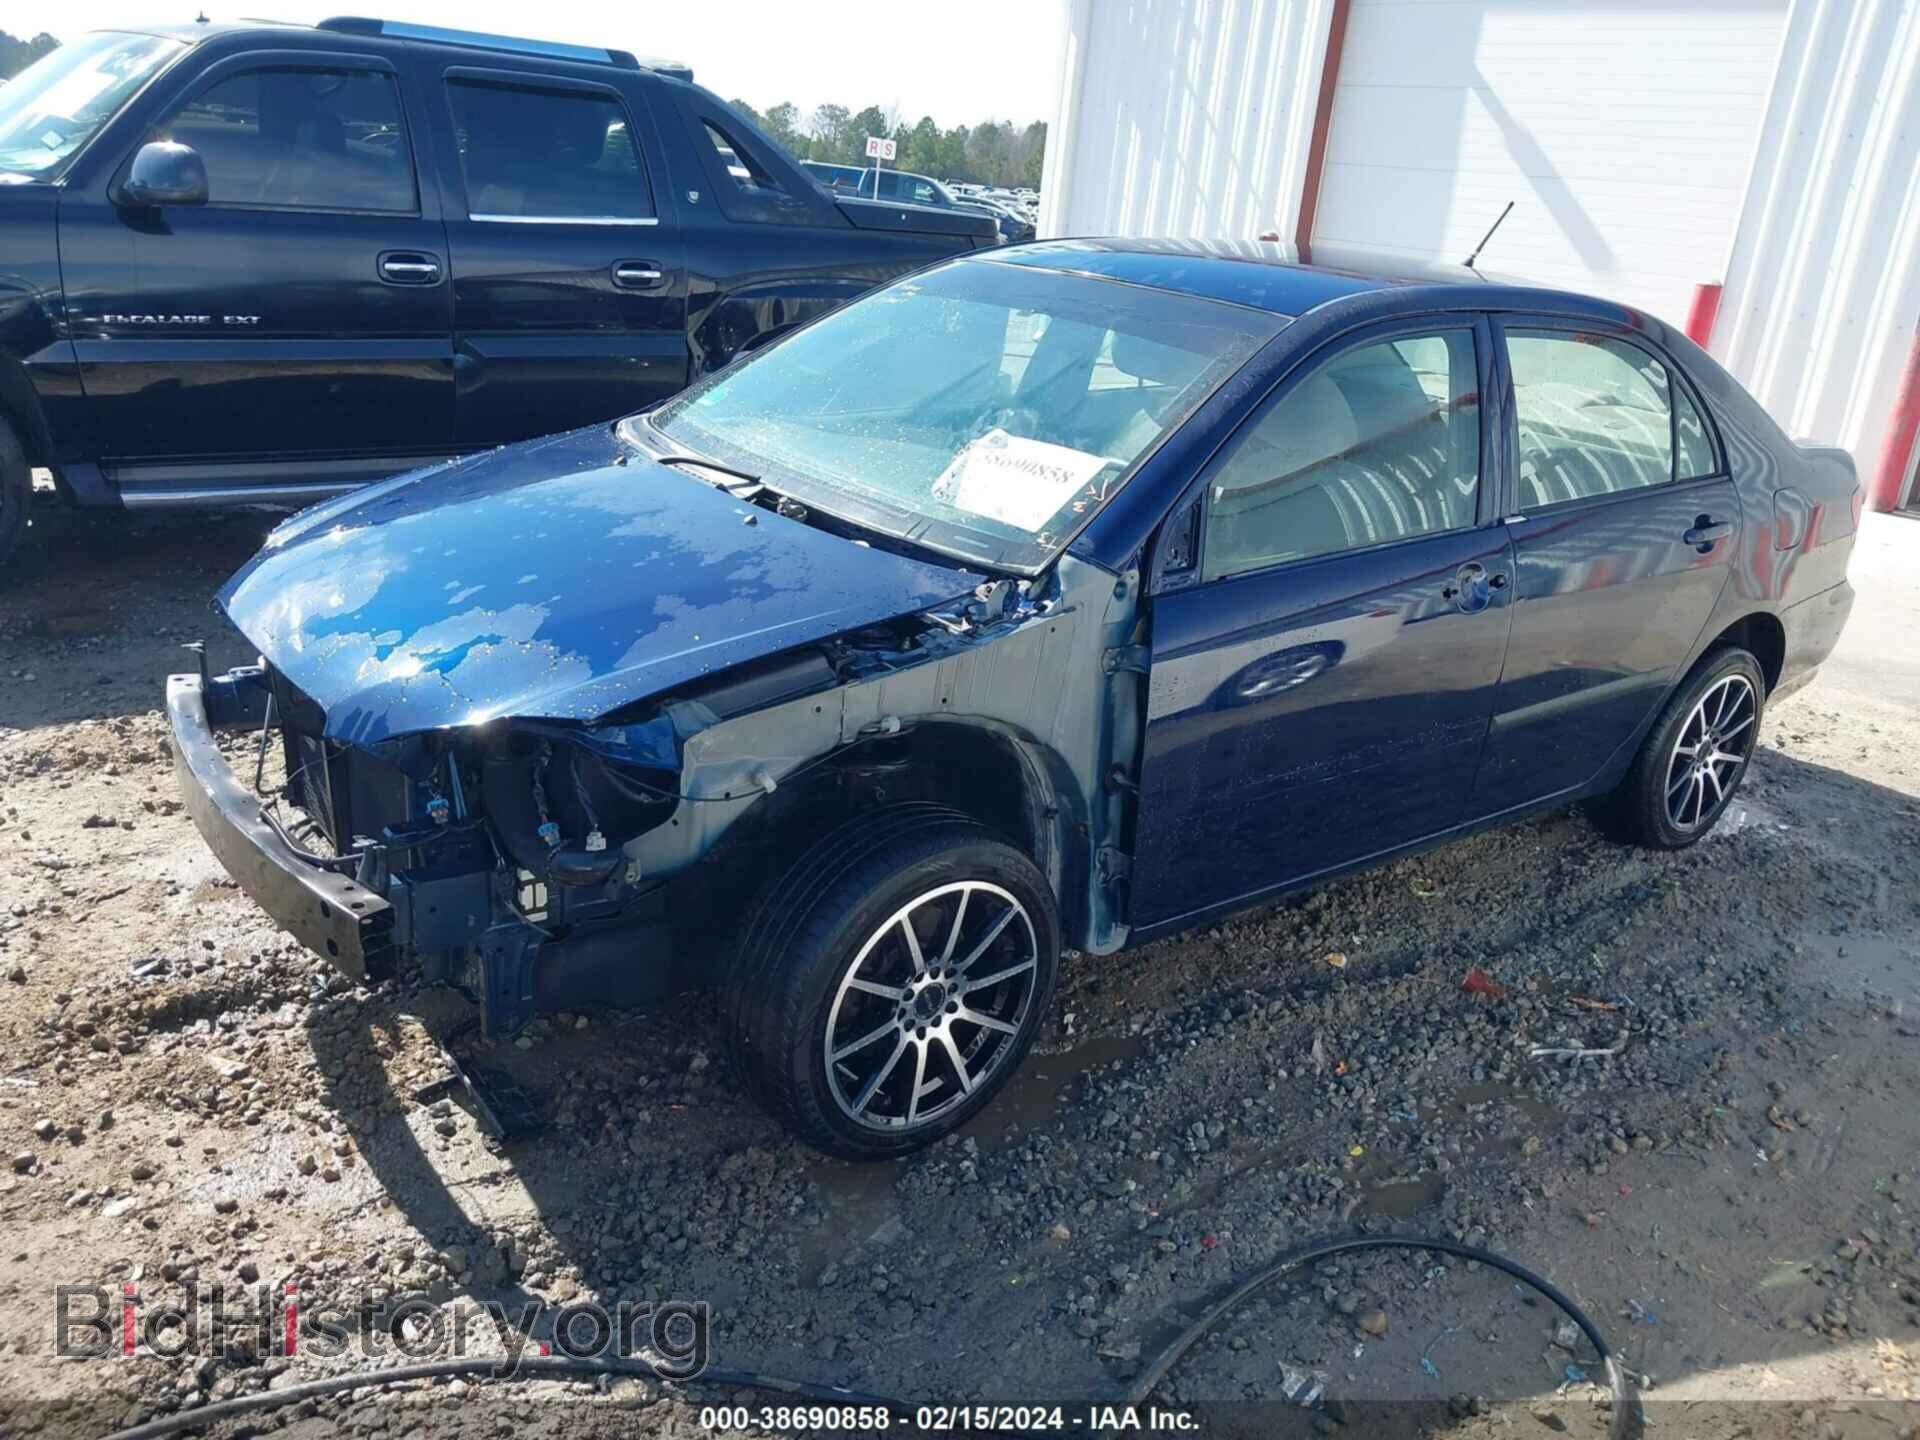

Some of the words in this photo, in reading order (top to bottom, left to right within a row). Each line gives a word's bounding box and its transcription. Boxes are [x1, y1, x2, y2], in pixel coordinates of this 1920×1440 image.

[870, 140, 878, 154] R
[884, 143, 893, 157] S
[223, 315, 262, 324] EXT
